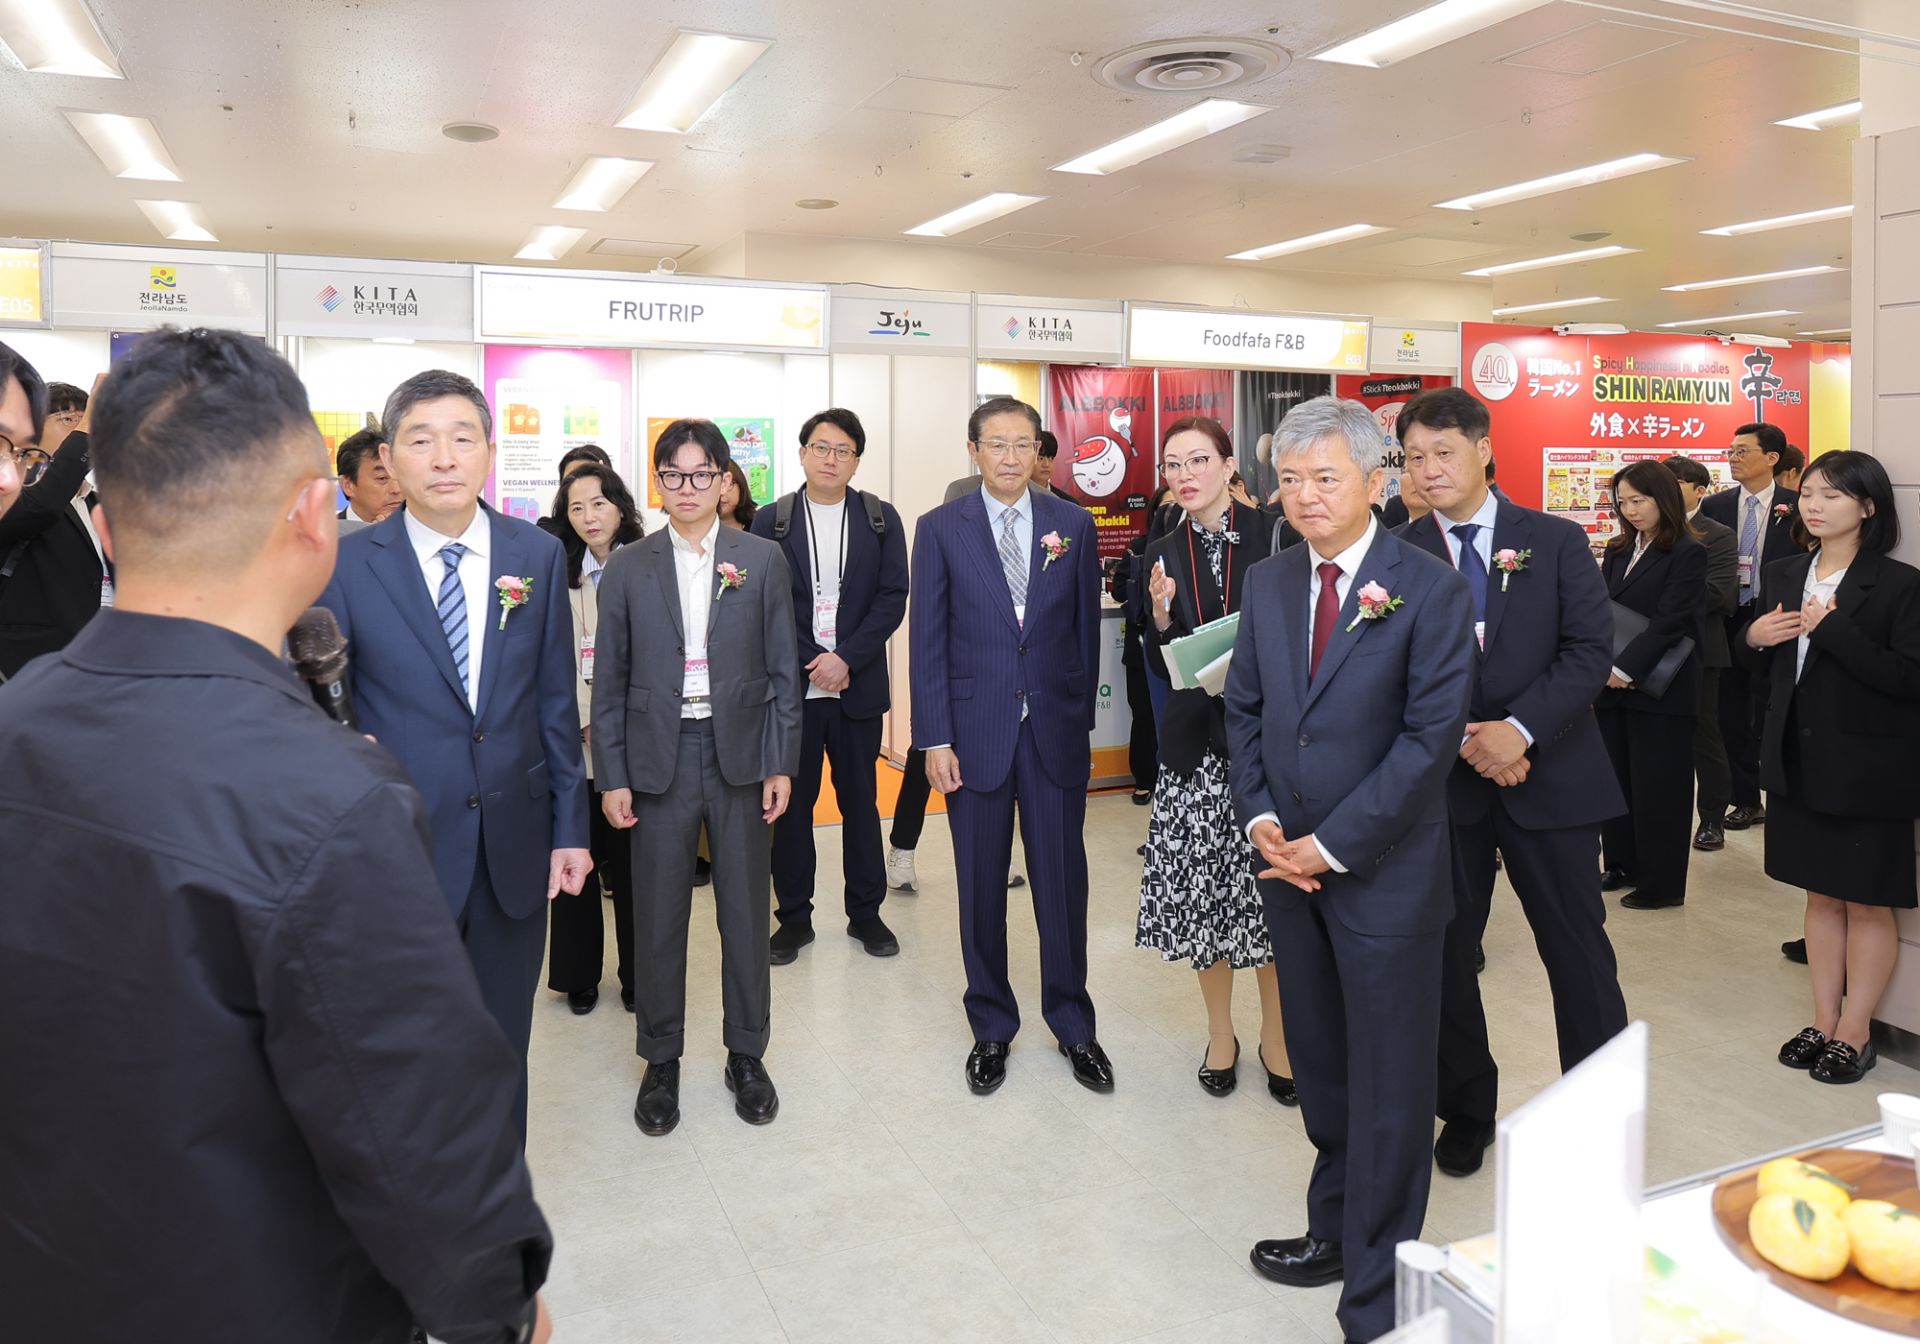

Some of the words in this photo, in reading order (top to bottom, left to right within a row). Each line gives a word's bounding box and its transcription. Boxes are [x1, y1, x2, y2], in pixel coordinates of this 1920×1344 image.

[139, 292, 188, 305] 전라남도
[353, 285, 418, 302] KITA
[353, 300, 418, 316] 한국무역협회
[609, 300, 705, 323] FRUTRIP
[877, 310, 922, 336] Jeju
[1028, 316, 1072, 330] KITA
[1028, 328, 1072, 342] 한국무역협회
[1203, 329, 1271, 349] Foodfafa
[1275, 333, 1305, 350] F&B
[1593, 354, 1624, 374] Spicy
[1625, 357, 1678, 375] Happiness
[1528, 378, 1580, 398] ラーメン
[1594, 374, 1648, 402] SHIN
[1651, 376, 1732, 405] RAMYUN
